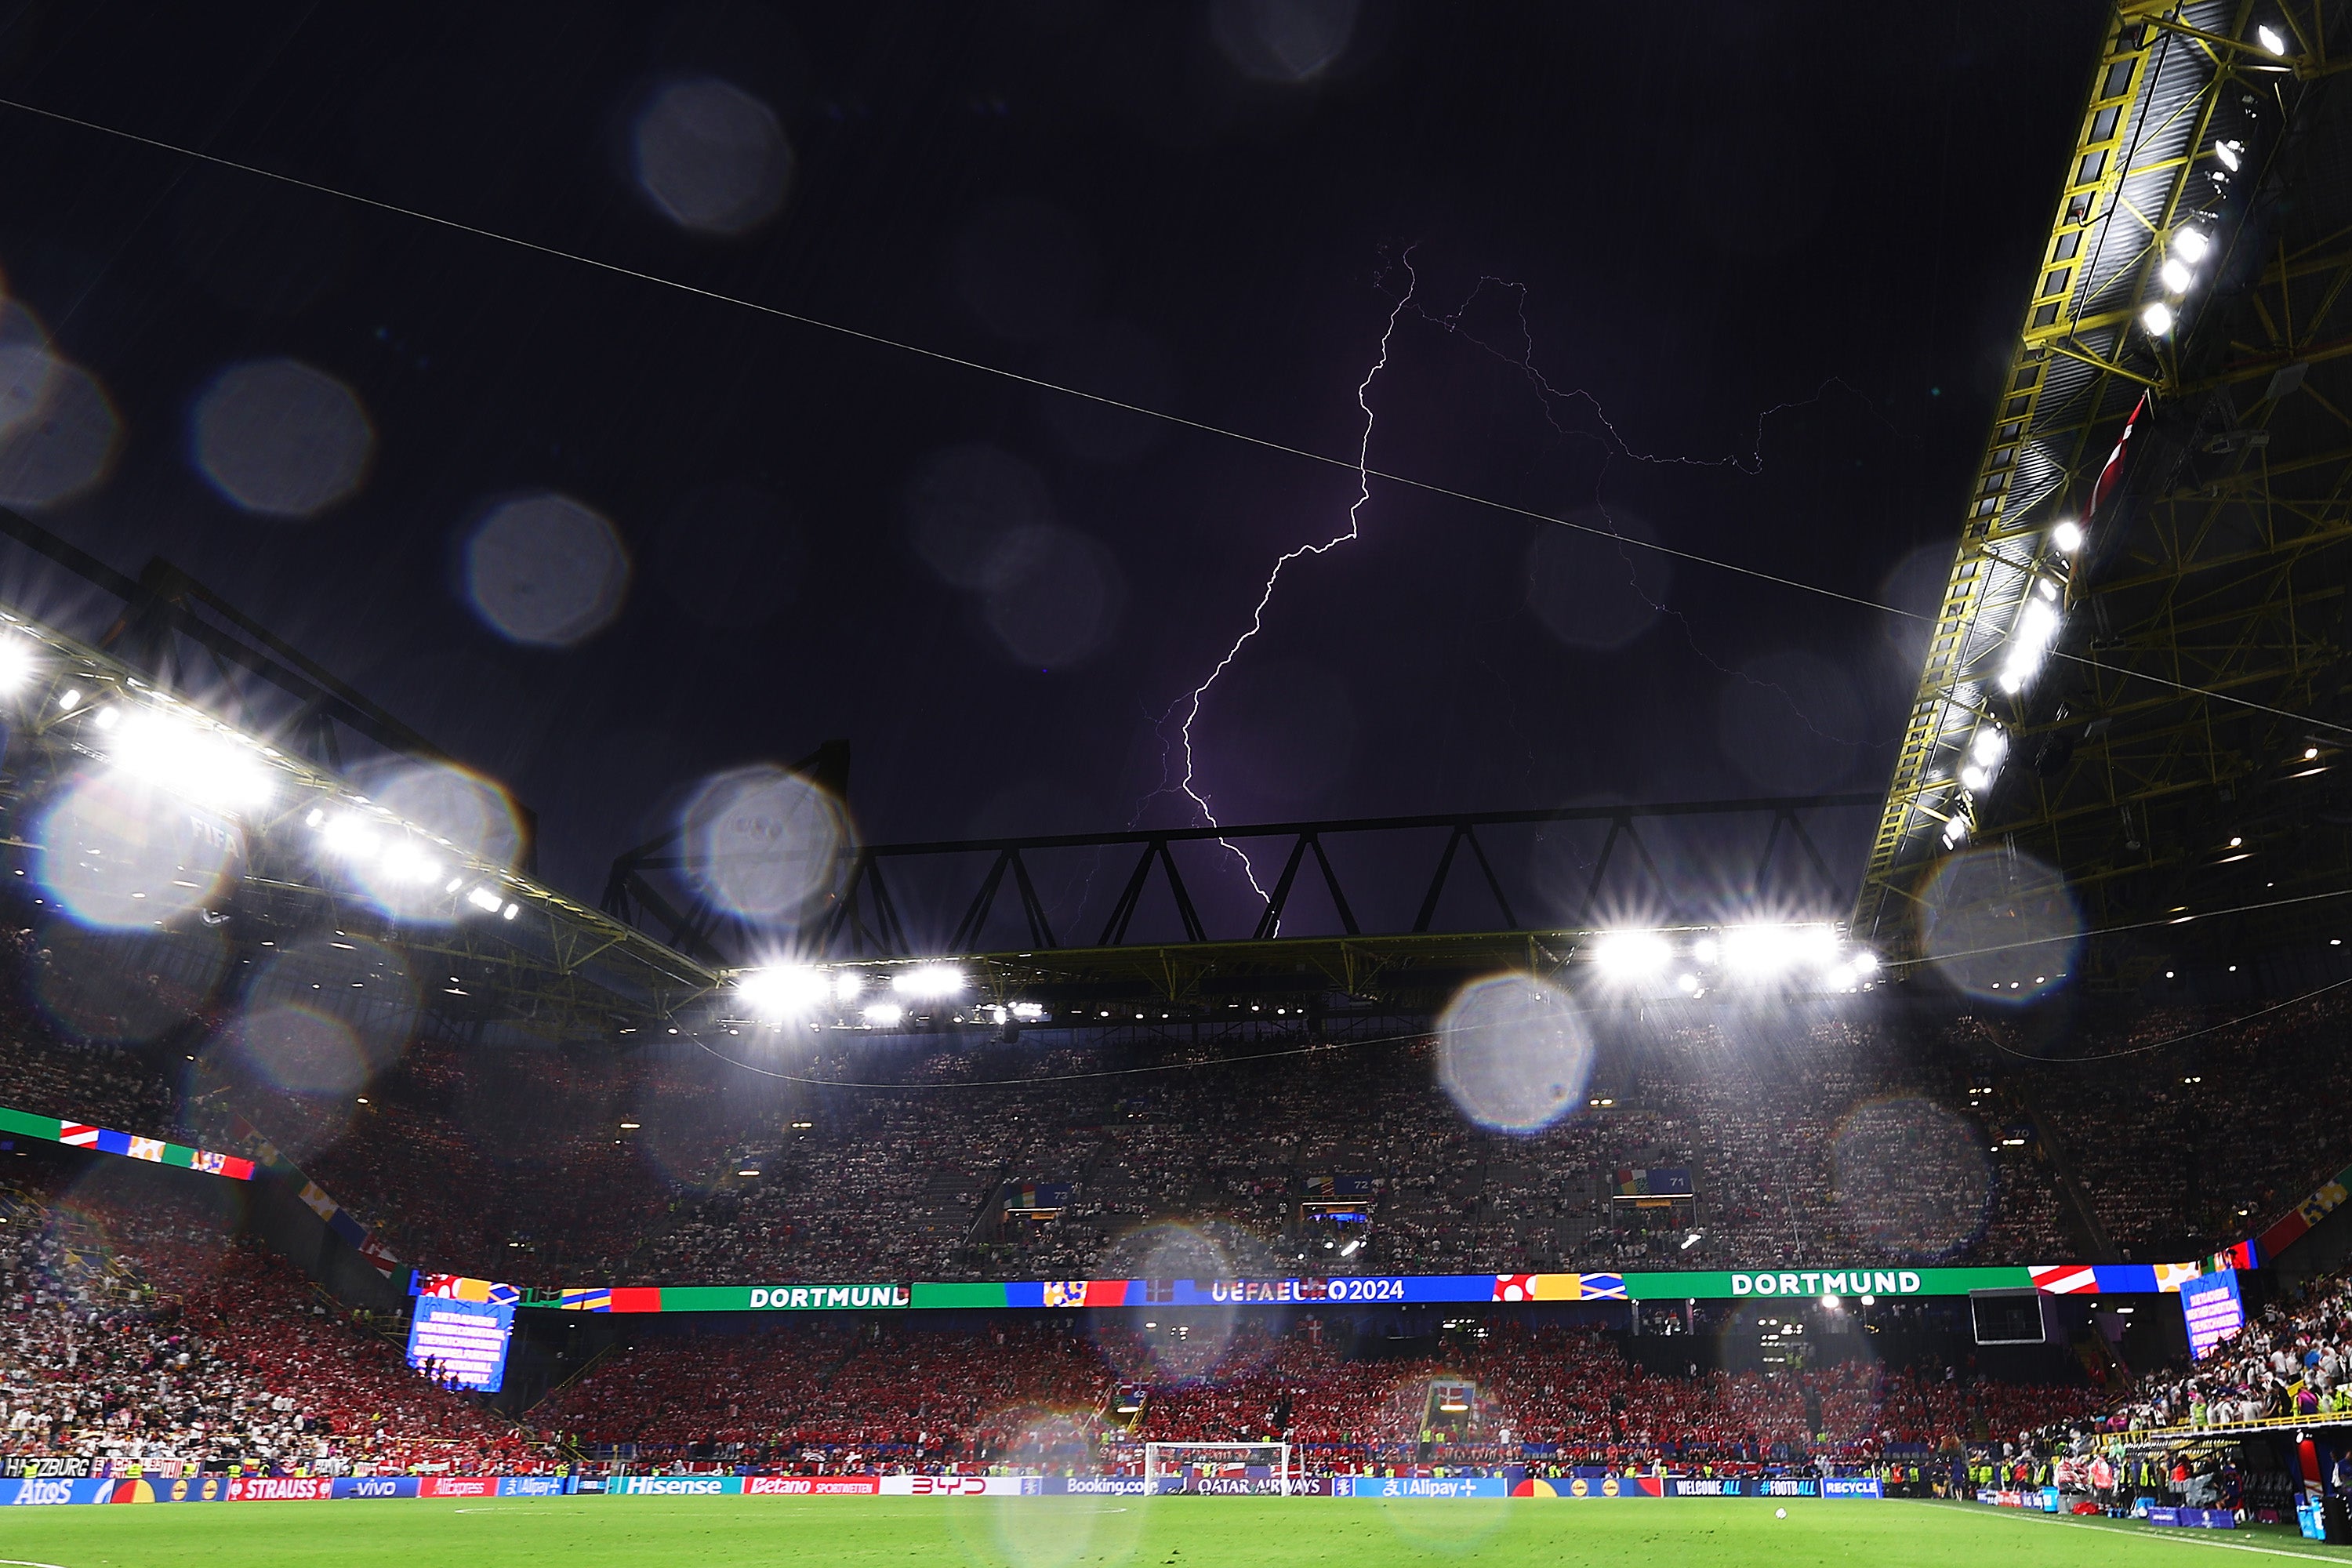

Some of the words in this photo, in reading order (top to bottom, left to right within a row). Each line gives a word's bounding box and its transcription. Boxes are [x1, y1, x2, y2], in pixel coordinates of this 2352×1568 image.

[2013, 1129, 2030, 1138] 70
[1354, 1181, 1369, 1189] 72
[1670, 1178, 1684, 1186] 71
[1054, 1192, 1068, 1200] 73
[1731, 1272, 1921, 1295] DORTMUND
[1134, 1389, 1146, 1398] 62
[245, 1479, 317, 1499] STRAUSS
[357, 1479, 396, 1496] vivo
[626, 1476, 722, 1494] Hisense
[750, 1478, 811, 1494] Betano
[815, 1483, 873, 1494] SPORTWETTEN
[912, 1478, 986, 1495] BYD
[1198, 1479, 1250, 1494] QATAR
[1760, 1480, 1816, 1496] #FOOTBALL
[1826, 1482, 1878, 1494] RECYCLE
